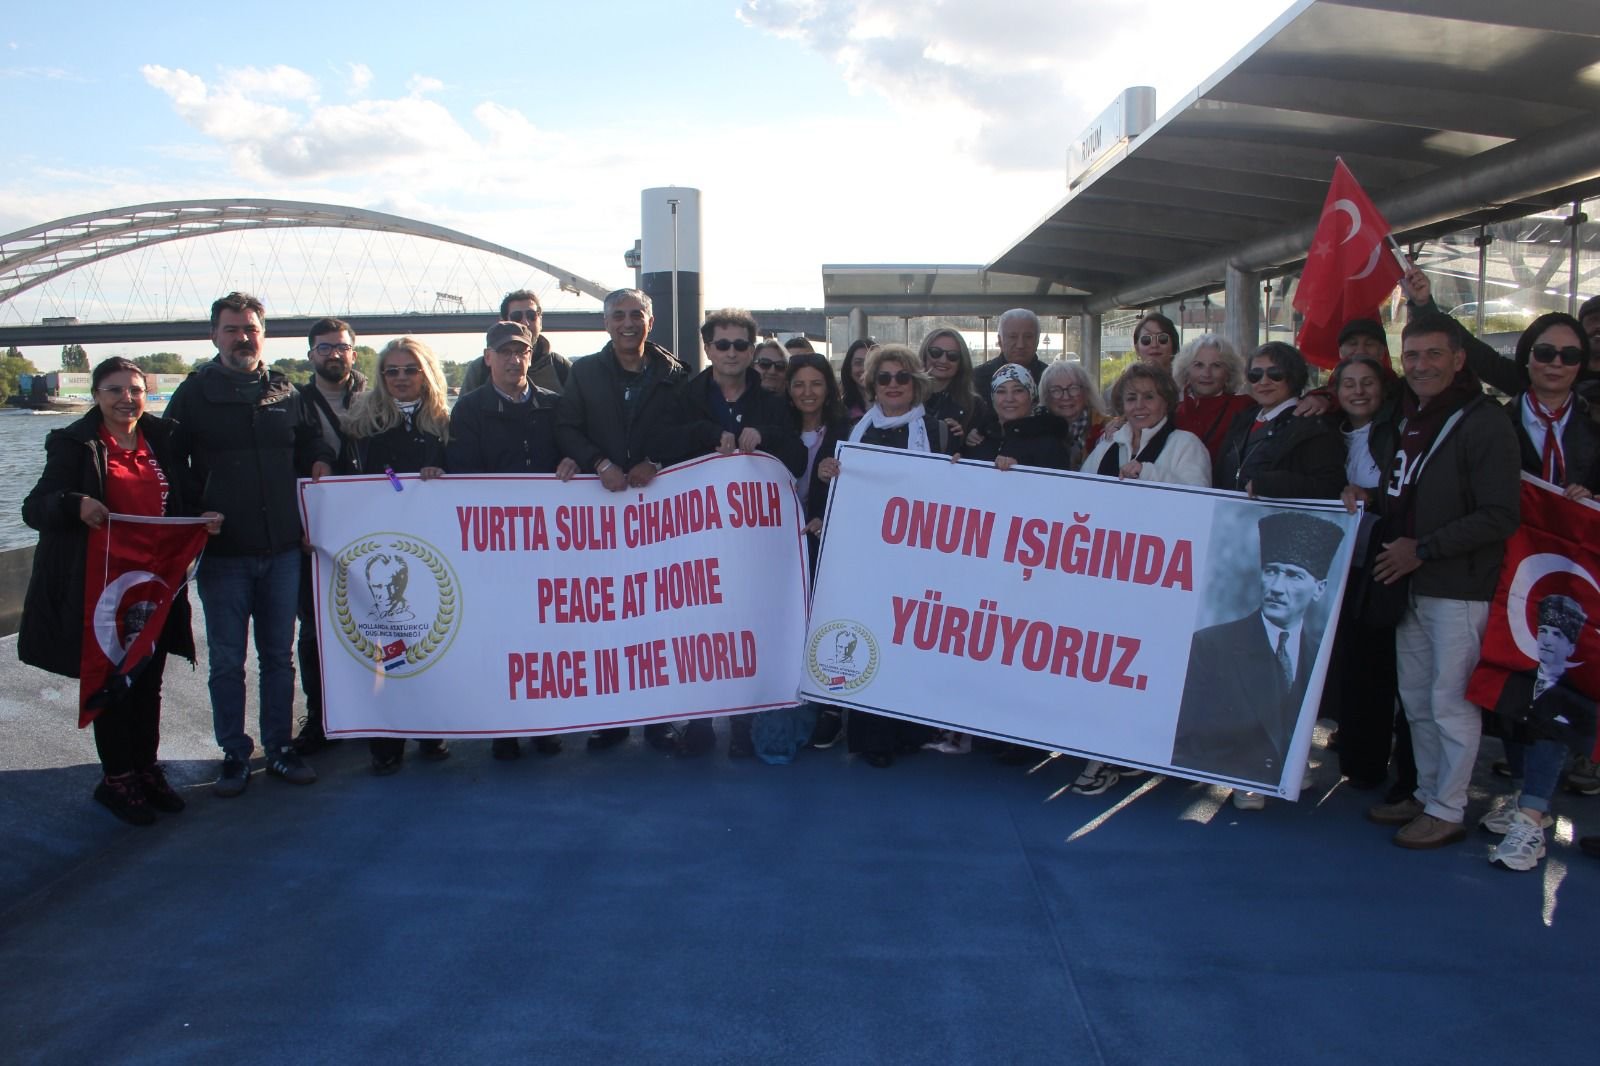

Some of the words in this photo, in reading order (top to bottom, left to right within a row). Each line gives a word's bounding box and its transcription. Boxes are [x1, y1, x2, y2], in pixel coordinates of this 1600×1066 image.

[456, 506, 549, 551] YURTTA
[556, 505, 617, 550] SULH
[624, 485, 722, 548] CİHANDA
[728, 481, 782, 528] SULH
[881, 496, 995, 559] ONUN
[1003, 512, 1193, 591] IŞIĞINDA
[538, 577, 615, 623] PEACE
[622, 572, 648, 620] AT
[655, 557, 722, 612] HOME
[508, 650, 588, 700] PEACE
[595, 648, 619, 694] IN
[624, 640, 669, 690] THE
[672, 630, 757, 681] WORLD
[891, 589, 1148, 691] YÜRÜYORUZ.
